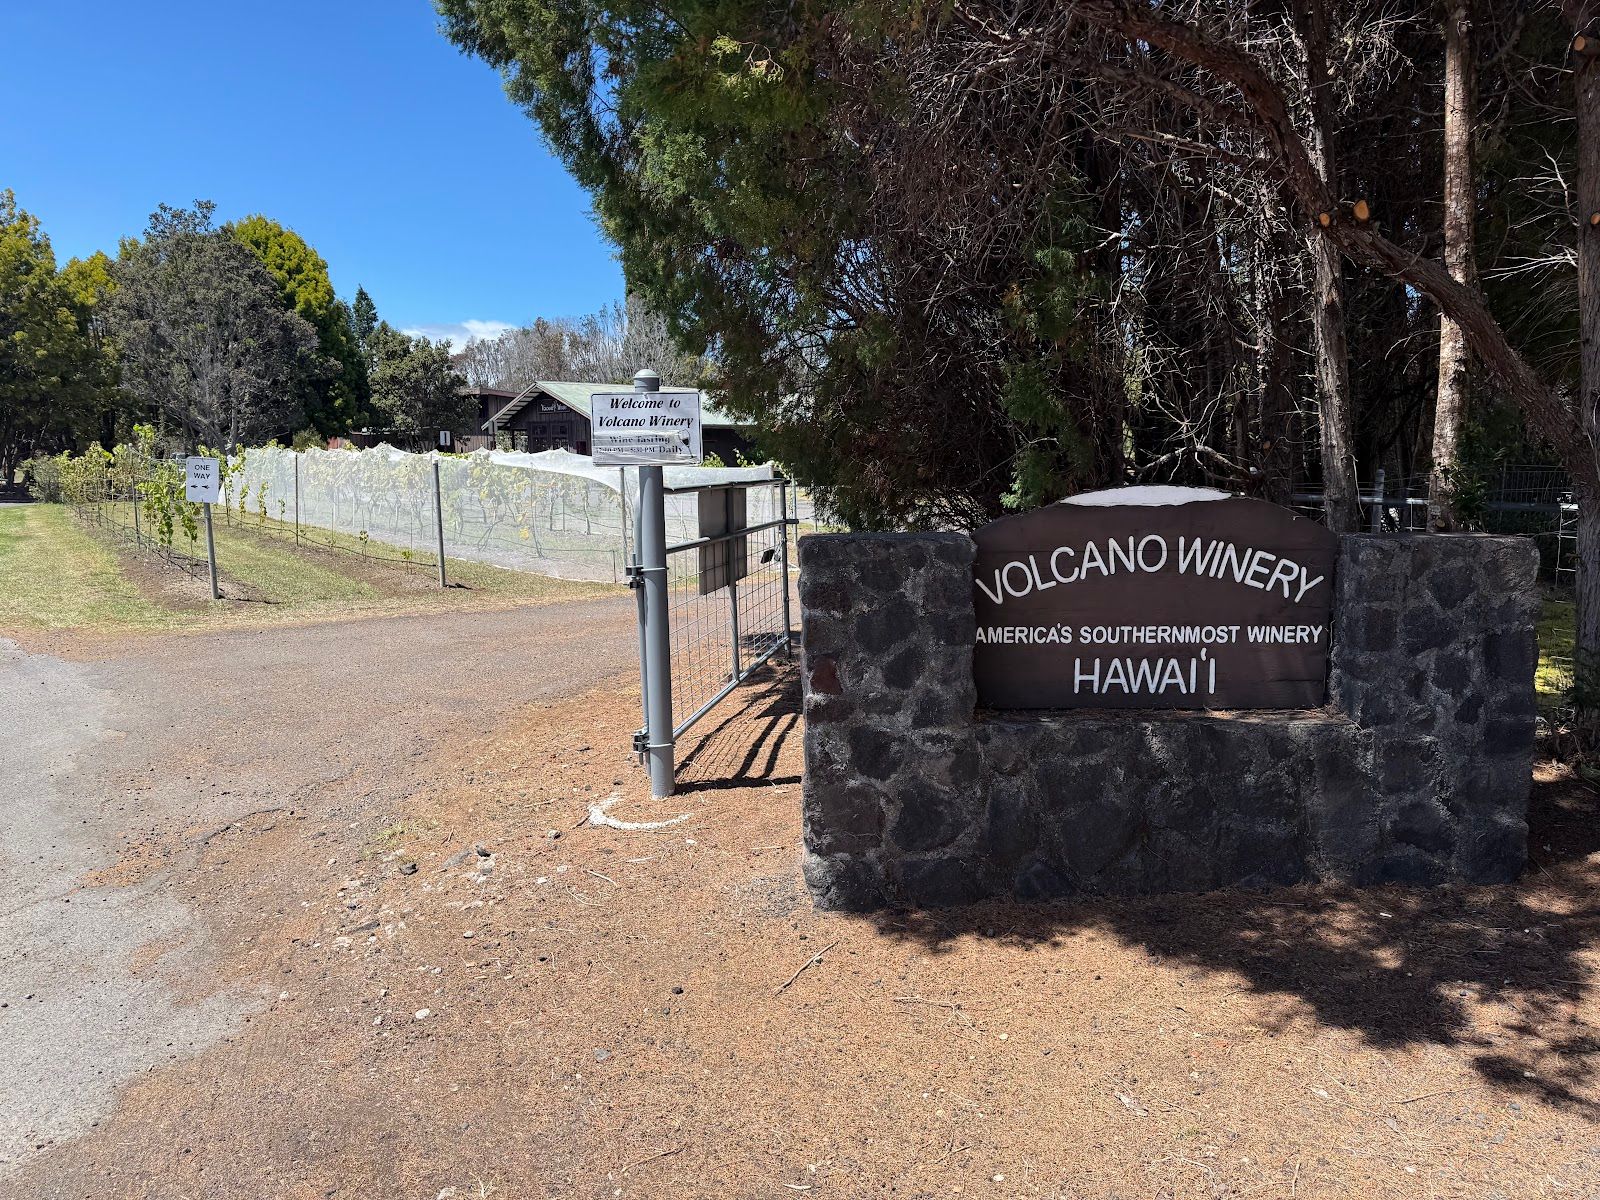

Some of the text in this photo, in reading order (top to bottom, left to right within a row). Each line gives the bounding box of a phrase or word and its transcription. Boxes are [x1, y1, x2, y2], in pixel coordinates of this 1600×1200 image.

[610, 398, 681, 409] Welcome to
[599, 415, 694, 428] Volcano Winery
[609, 435, 670, 444] Wine Tasting
[659, 445, 683, 454] Daily
[975, 534, 1324, 605] VOLCANO WINERY
[975, 623, 1323, 644] AMERICA'S SOUTHERNMOST WINERY
